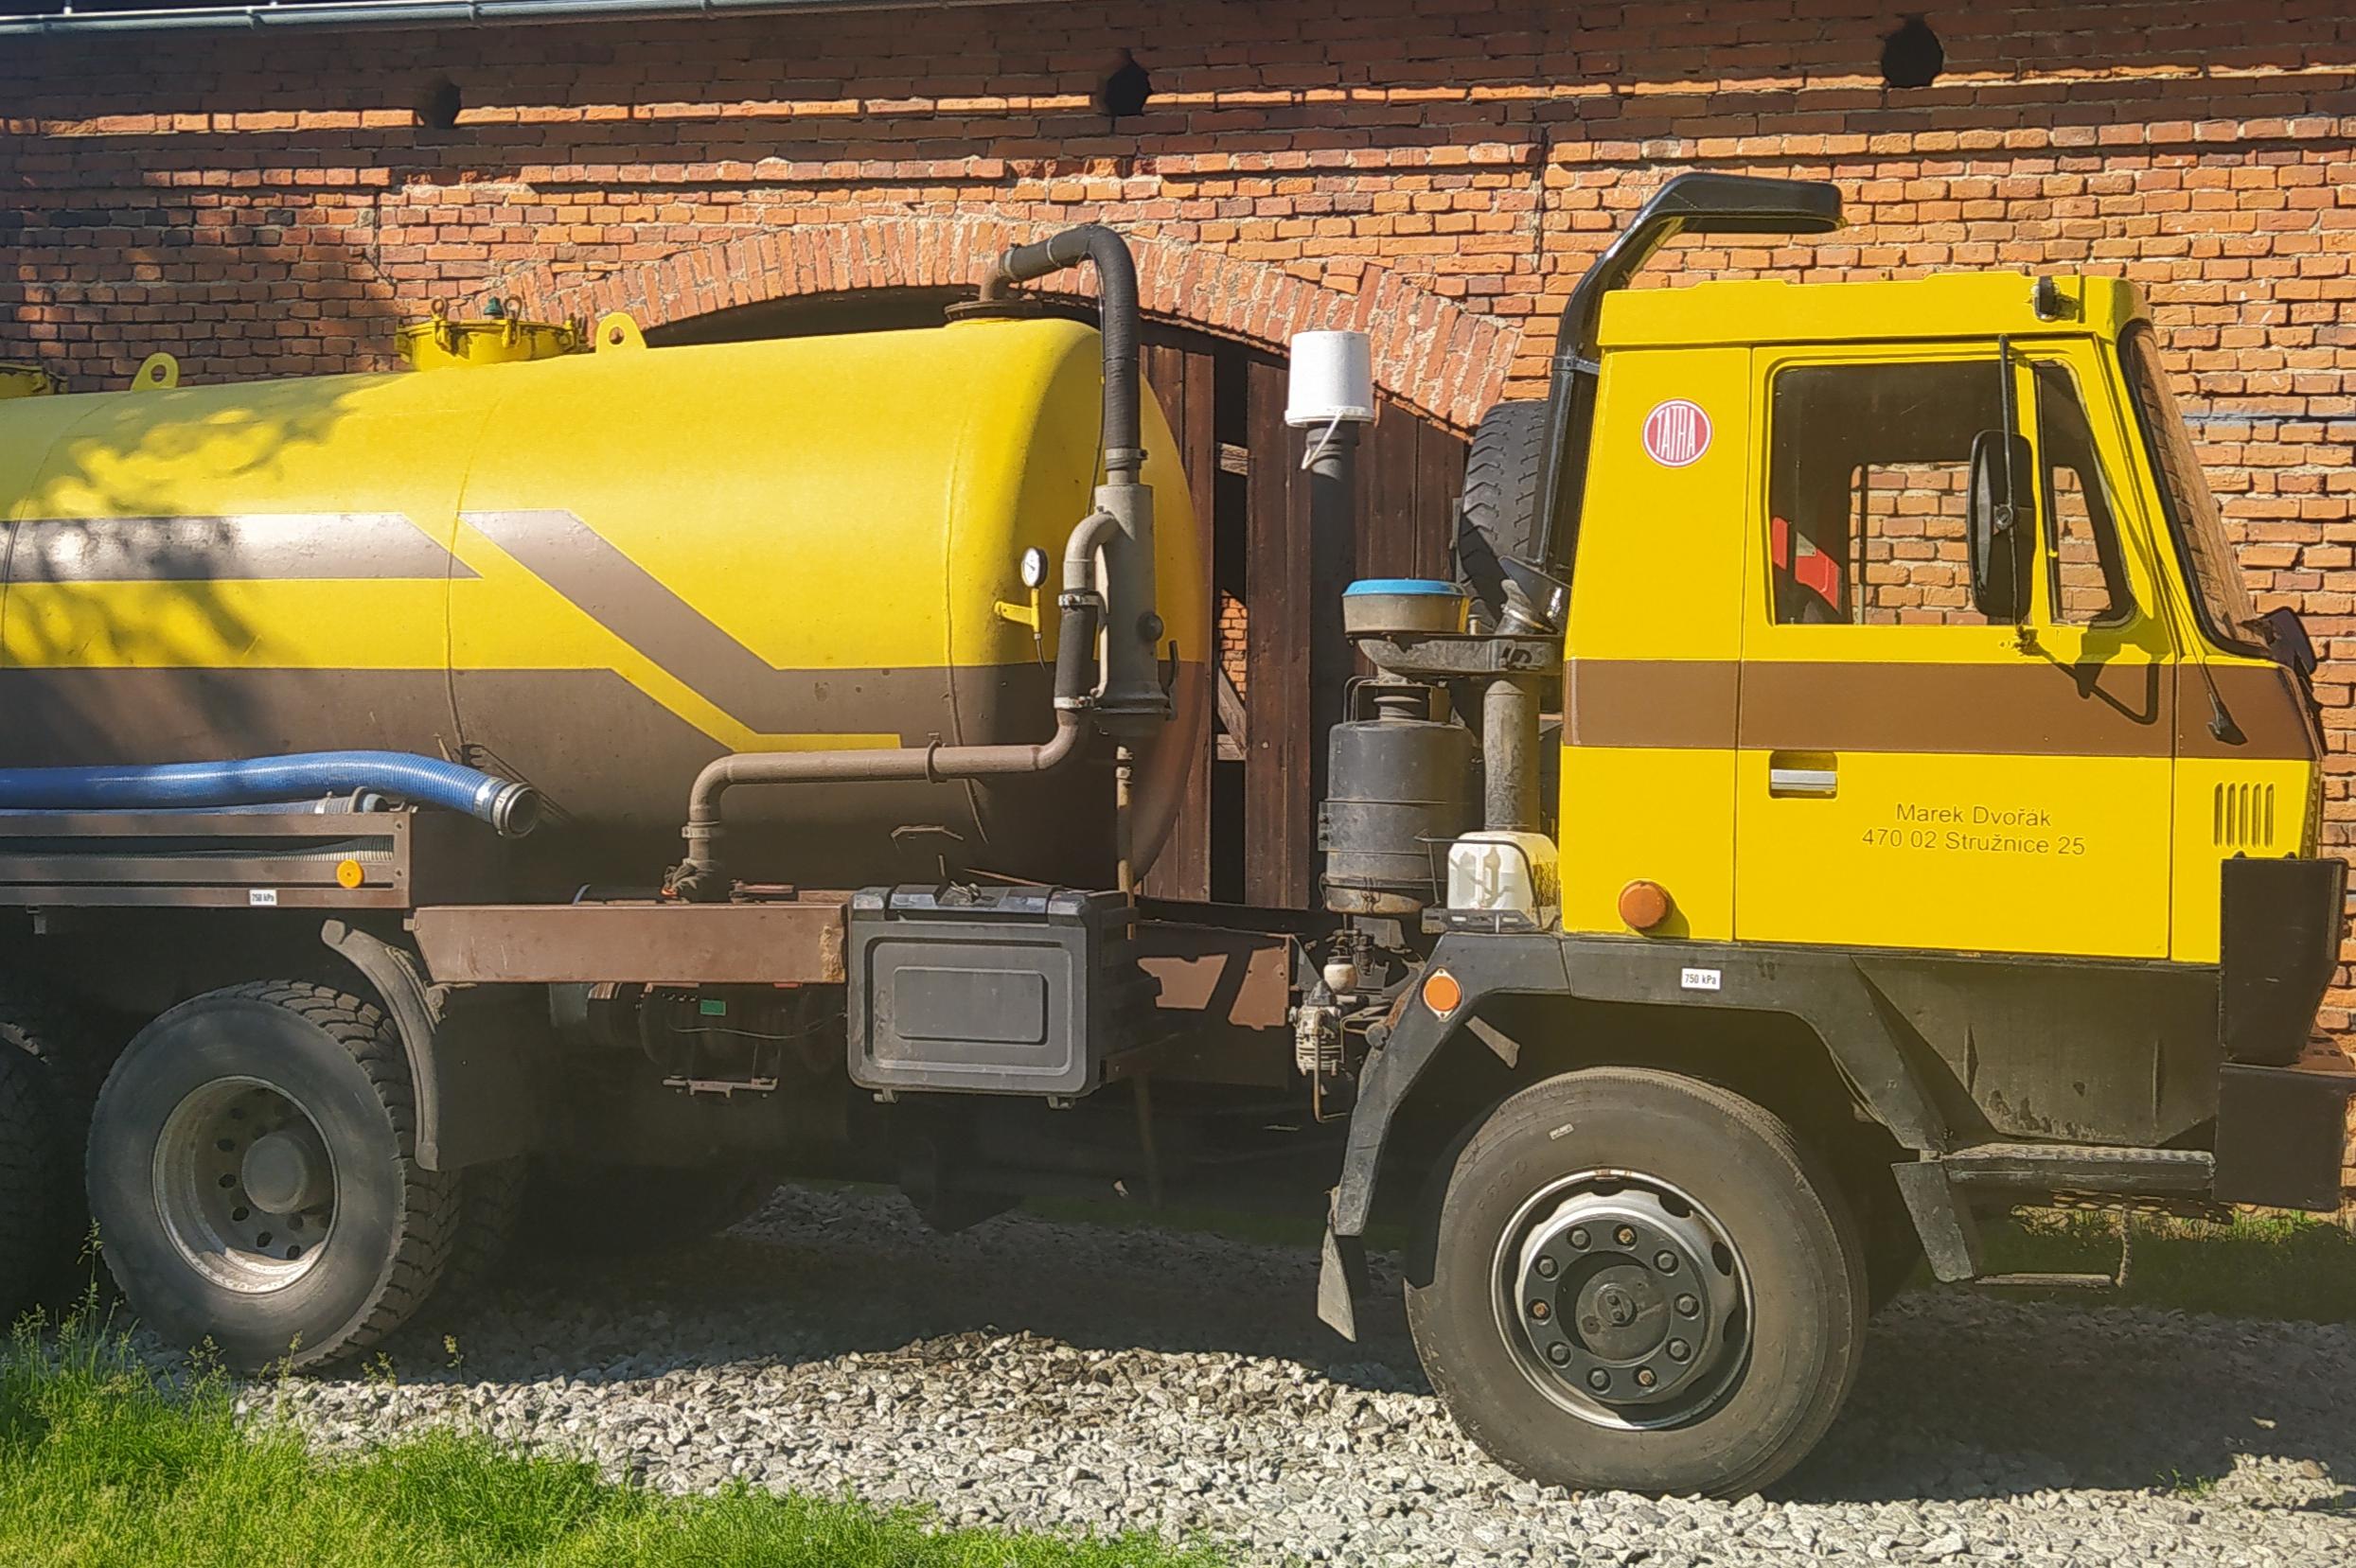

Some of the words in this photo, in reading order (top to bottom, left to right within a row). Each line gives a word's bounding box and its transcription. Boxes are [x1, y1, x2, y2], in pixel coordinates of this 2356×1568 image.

[1656, 406, 1696, 461] TATRA
[1896, 802, 1964, 823] Marek
[1973, 805, 2052, 827] Dvořák
[1862, 829, 1903, 847] 470
[1910, 830, 1938, 849] 02
[1945, 831, 2049, 854] Stružnice
[2058, 836, 2085, 855] 25
[1684, 973, 1700, 984] 750
[1701, 974, 1717, 985] kPa
